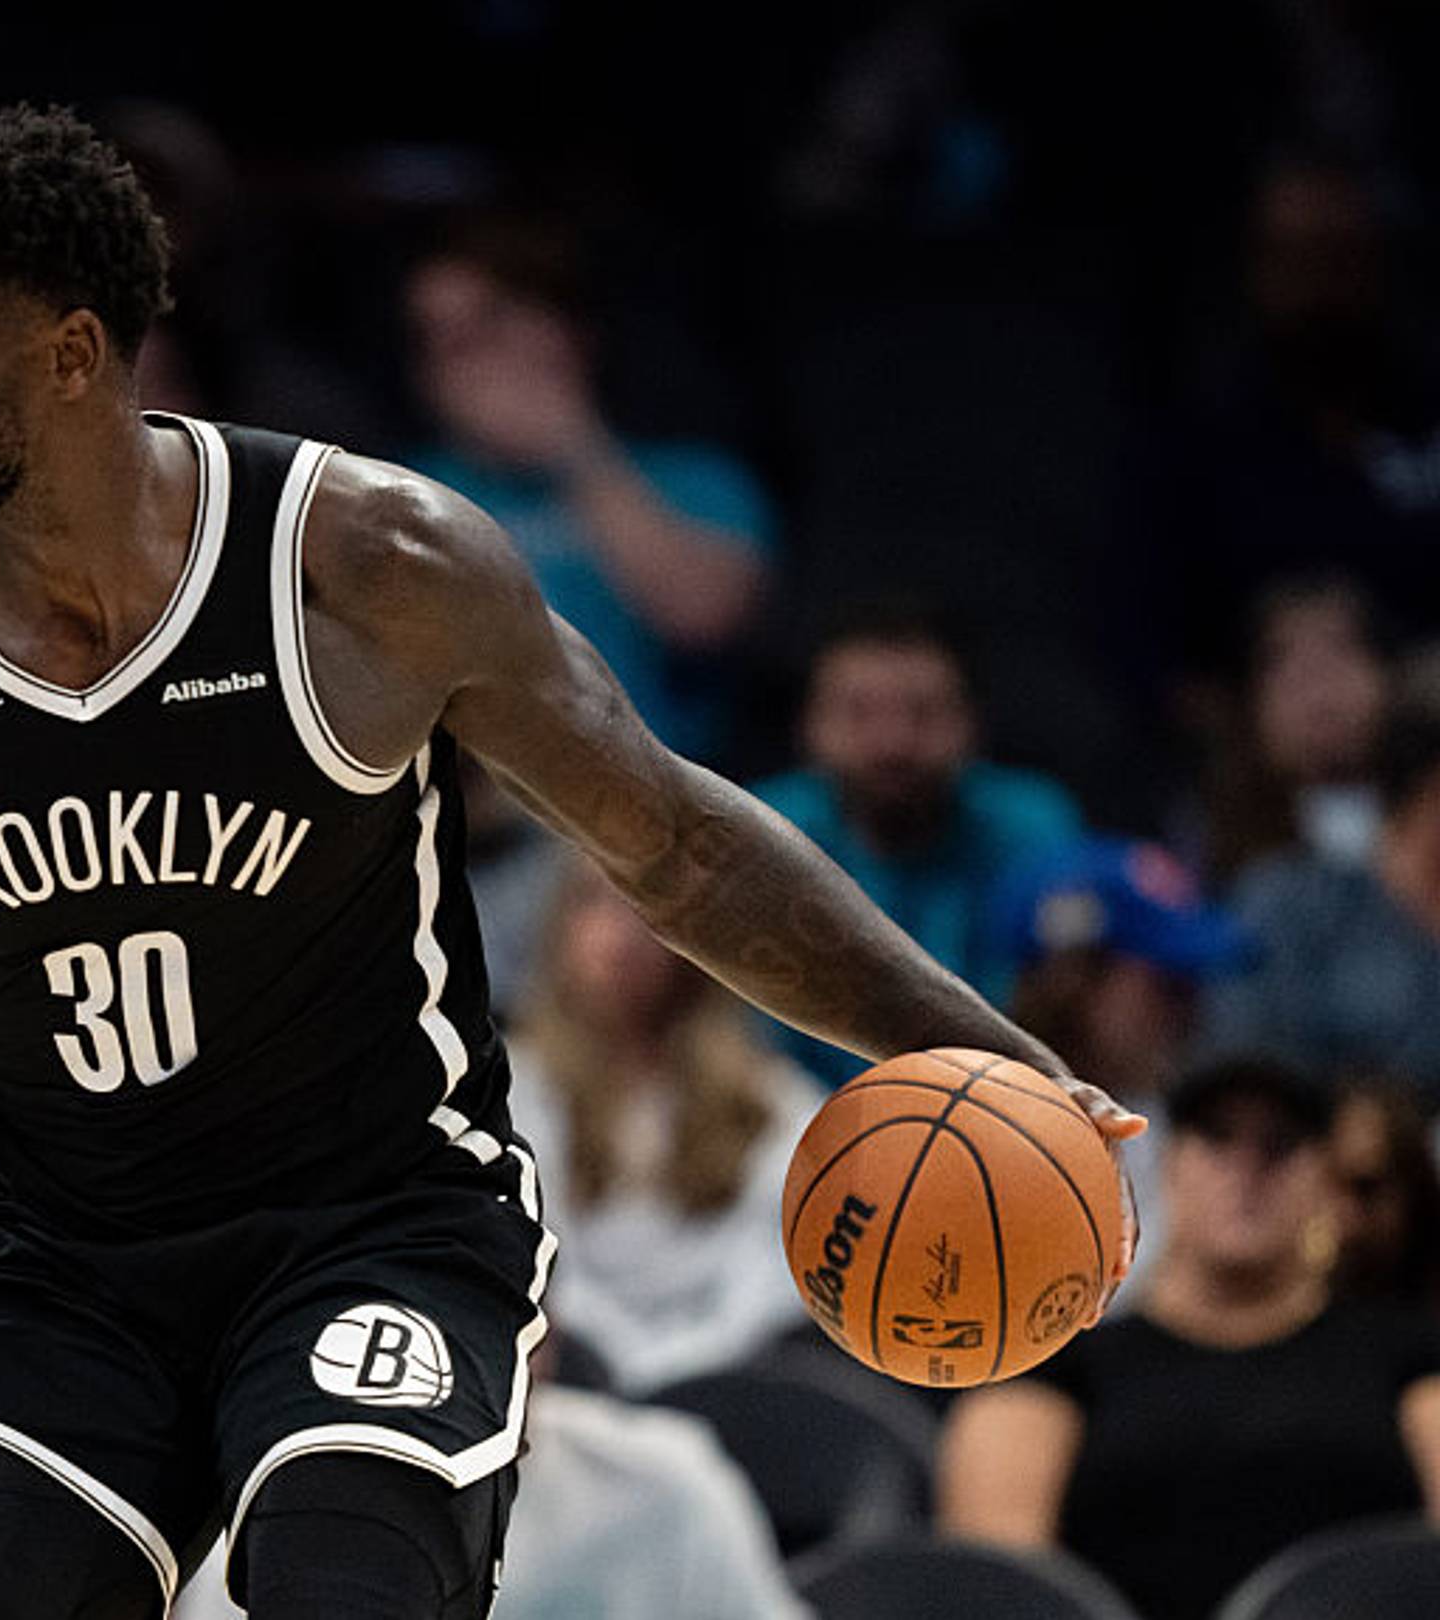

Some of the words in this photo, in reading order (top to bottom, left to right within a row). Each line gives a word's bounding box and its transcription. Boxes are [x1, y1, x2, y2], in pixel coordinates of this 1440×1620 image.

[160, 672, 266, 704] Alibaba
[42, 930, 199, 1093] 30
[356, 1316, 412, 1389] B
